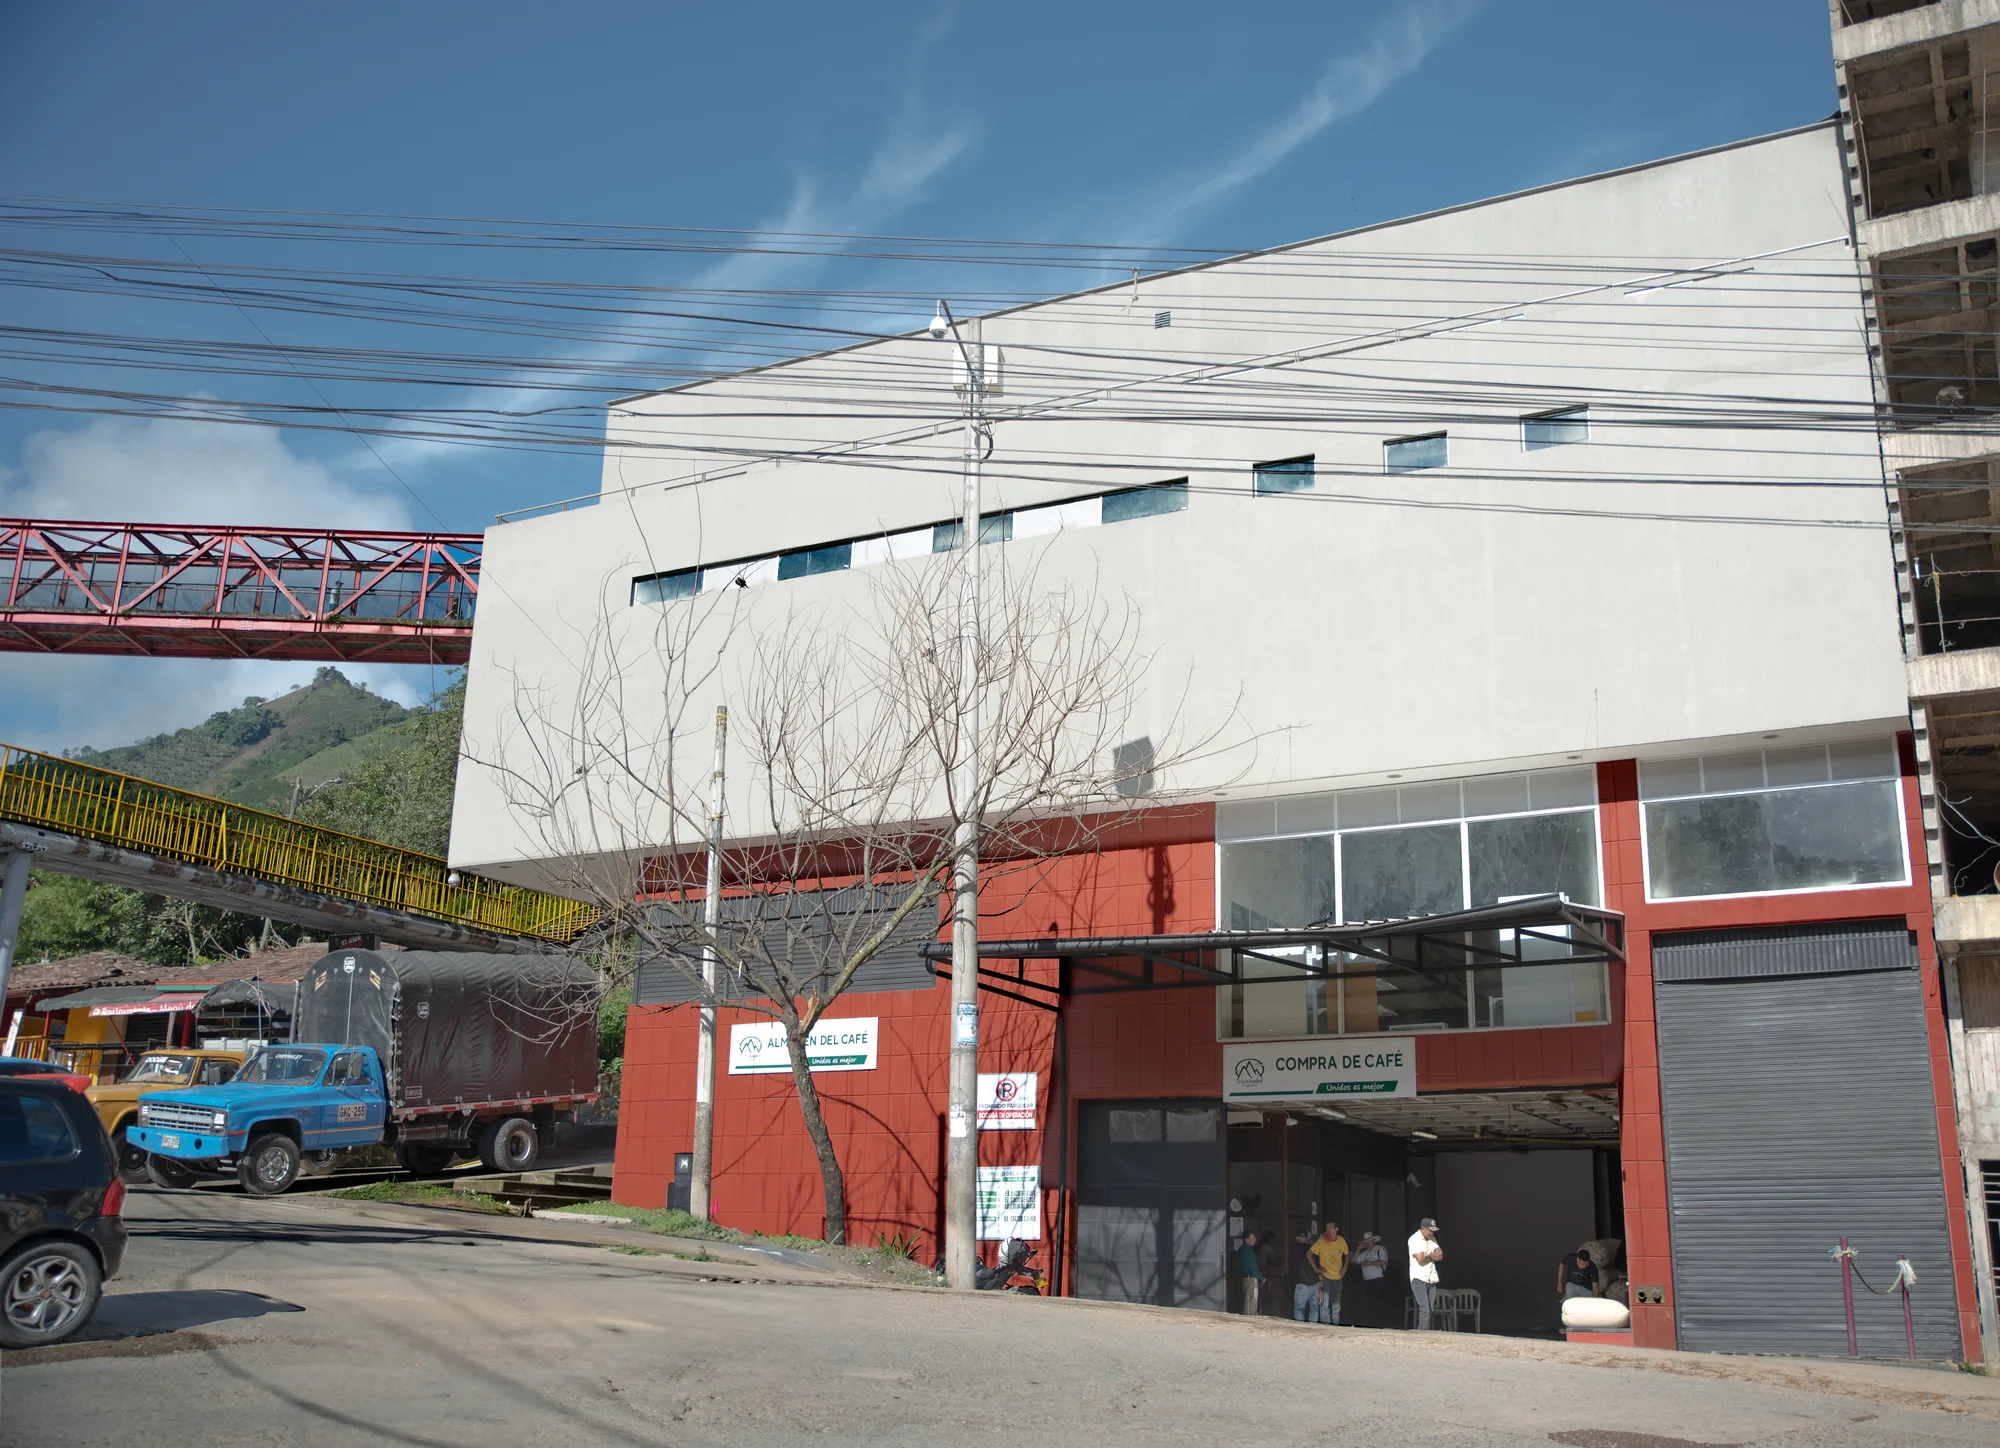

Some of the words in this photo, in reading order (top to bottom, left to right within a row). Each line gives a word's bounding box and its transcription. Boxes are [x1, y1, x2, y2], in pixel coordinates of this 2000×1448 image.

[768, 1036, 817, 1048] ALMEN
[820, 1034, 839, 1046] DEL
[841, 1030, 868, 1045] CAFÉ
[811, 1057, 831, 1065] Unidos
[839, 1057, 857, 1065] mejor
[1275, 1056, 1338, 1071] COMPRA
[1342, 1055, 1361, 1069] DE
[1364, 1049, 1403, 1068] CAFÉ
[1326, 1083, 1351, 1091] Unidos
[1362, 1083, 1385, 1091] mejor
[978, 1111, 998, 1119] BODEGA
[1006, 1110, 1033, 1119] OPERACIÓN
